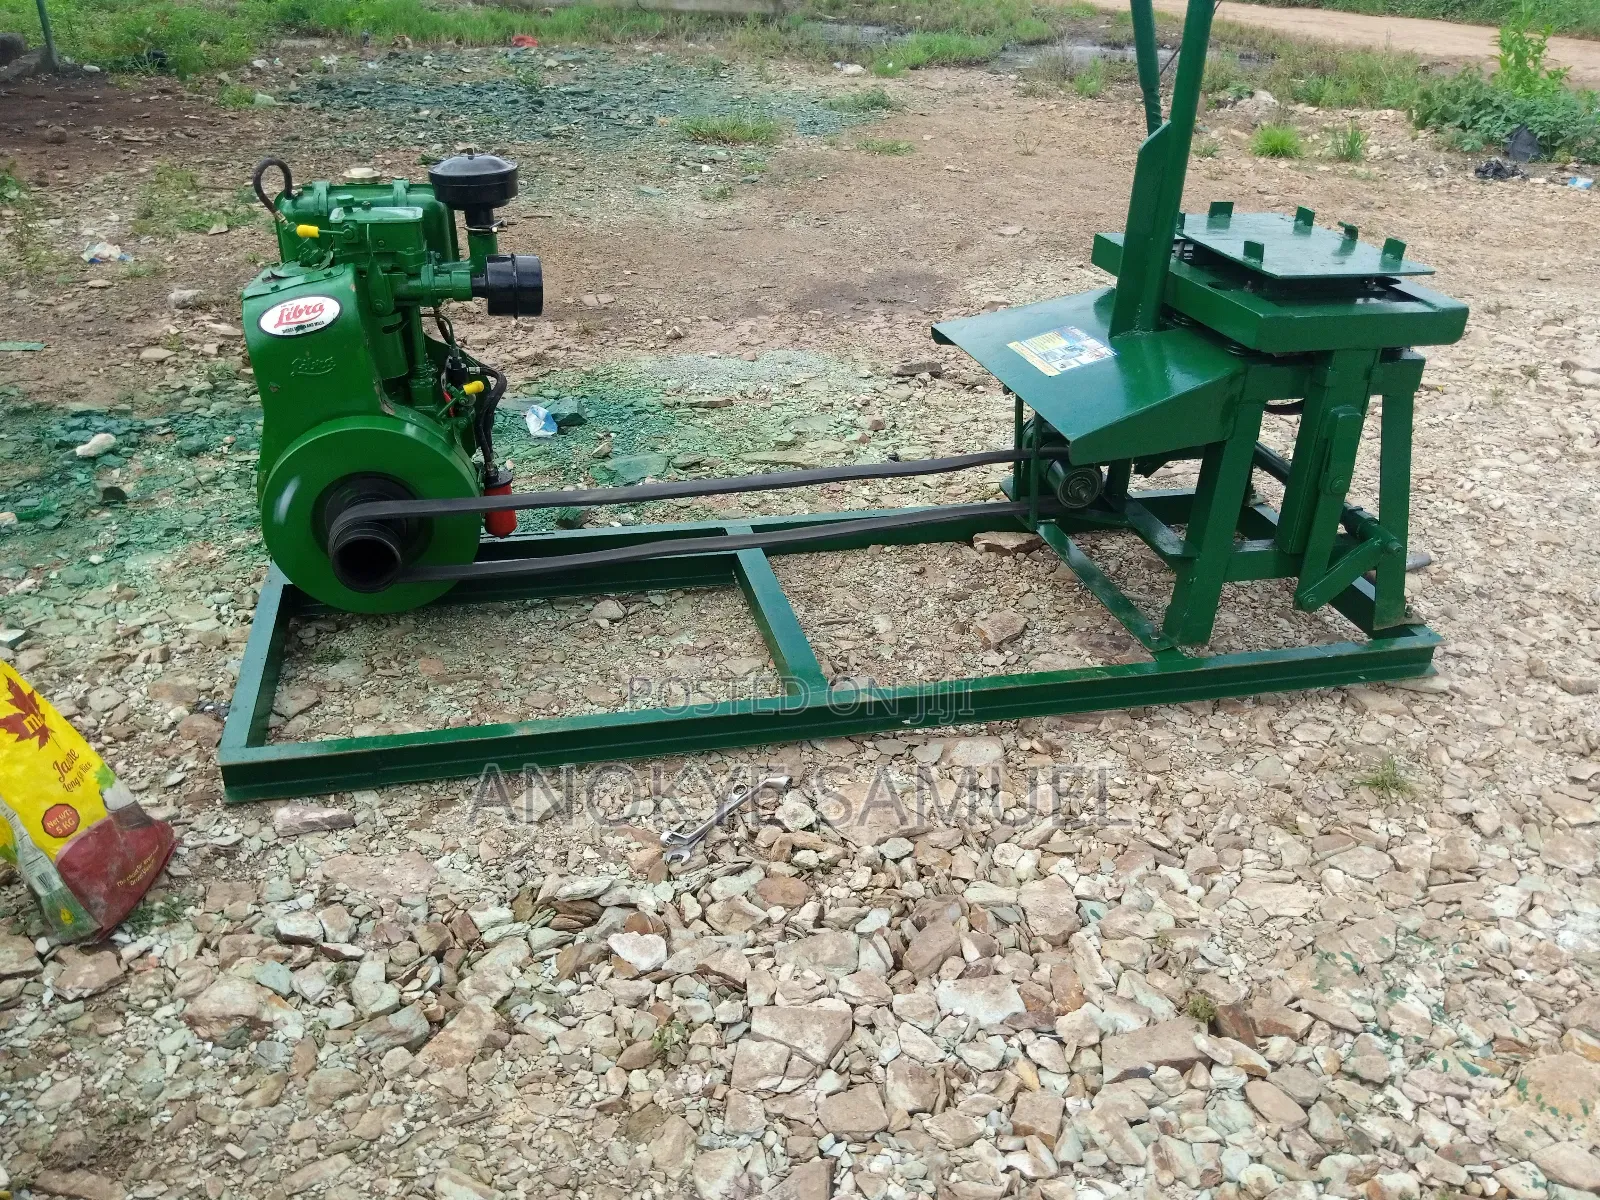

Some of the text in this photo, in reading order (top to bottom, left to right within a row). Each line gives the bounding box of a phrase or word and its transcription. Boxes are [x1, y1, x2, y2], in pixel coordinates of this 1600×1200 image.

[274, 303, 325, 328] Libra
[56, 817, 75, 834] 5 KG
